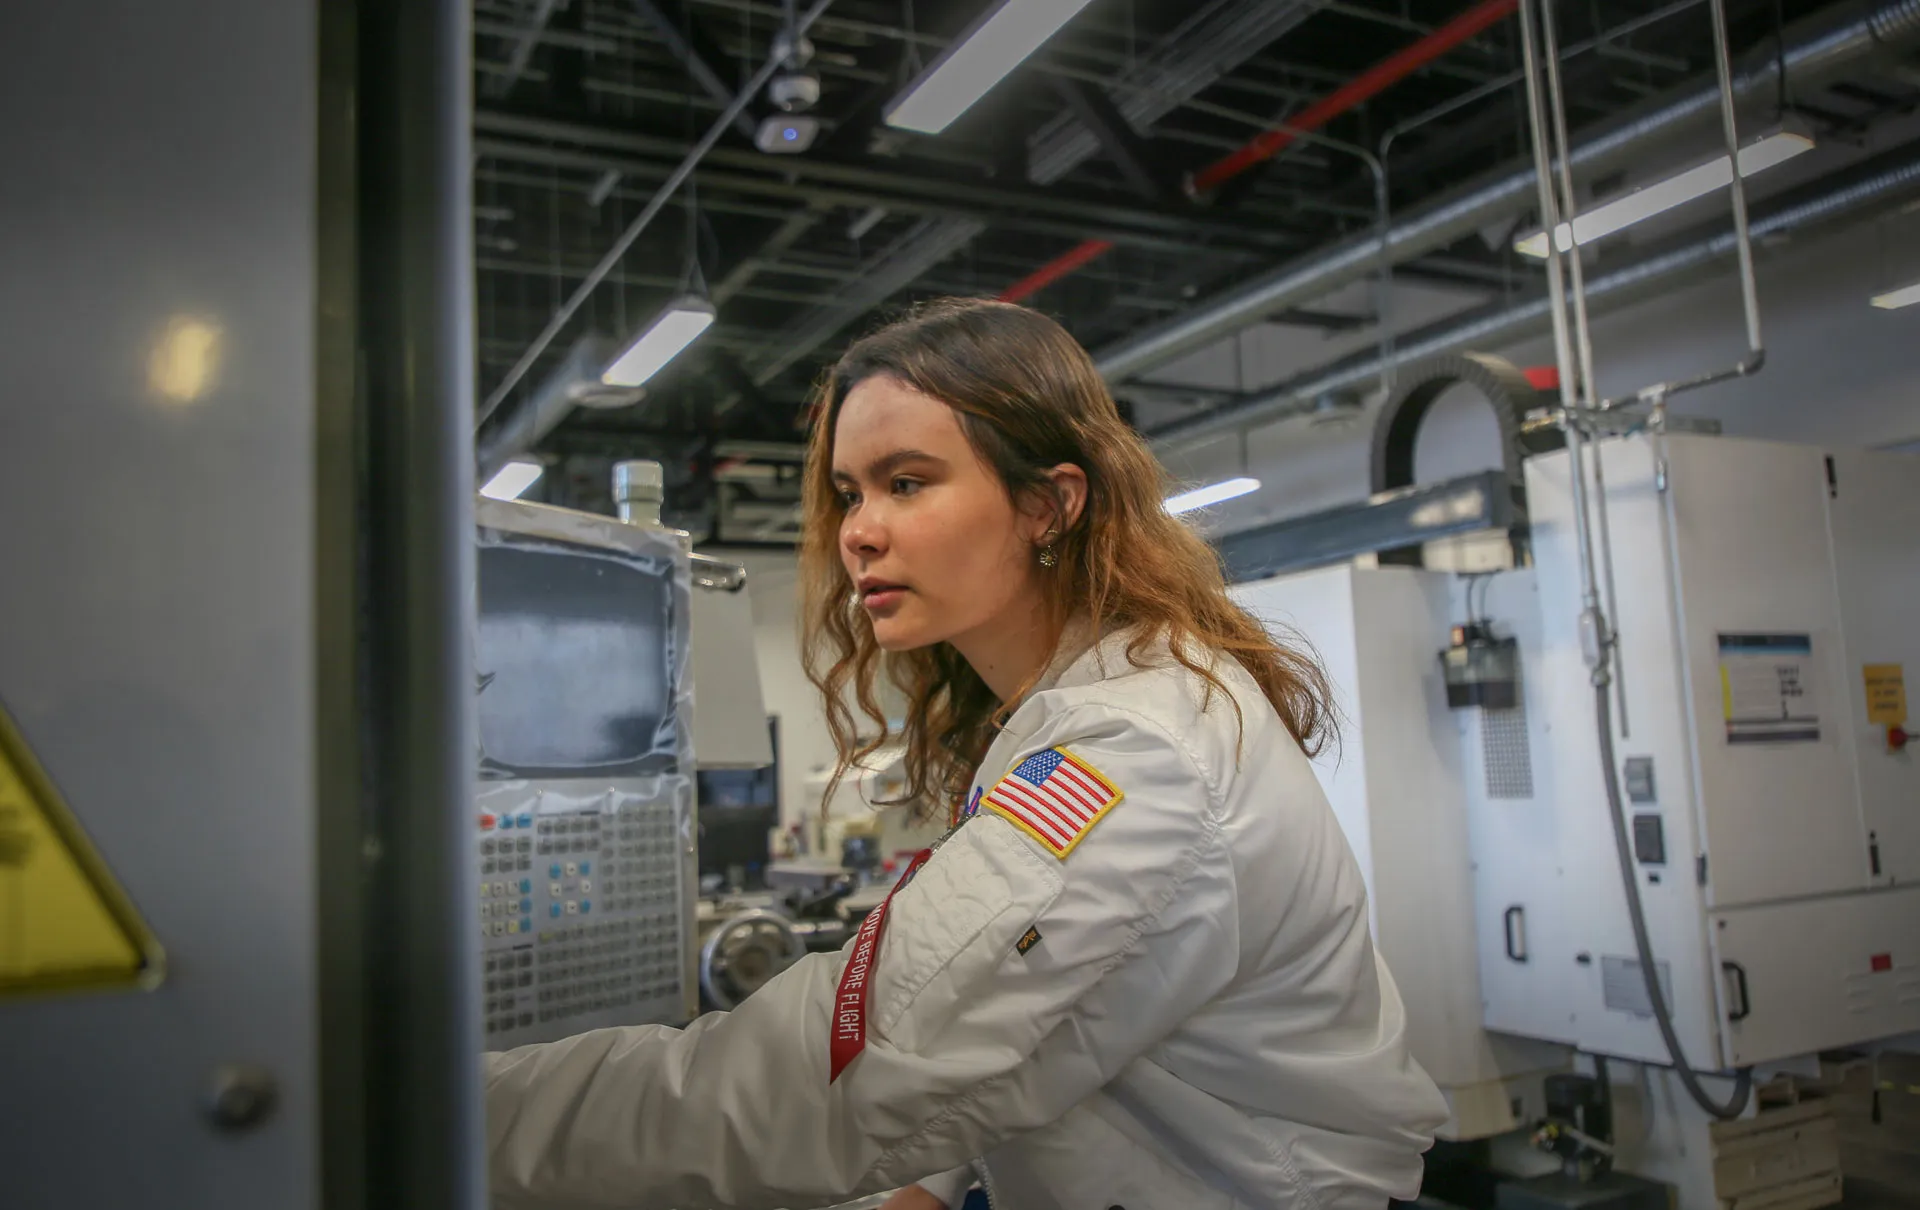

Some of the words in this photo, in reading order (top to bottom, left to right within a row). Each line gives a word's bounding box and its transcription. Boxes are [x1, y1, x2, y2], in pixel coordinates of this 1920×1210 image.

[861, 902, 885, 940] MOVE
[844, 940, 872, 990] BEFORE
[838, 993, 860, 1041] FLIGHT
